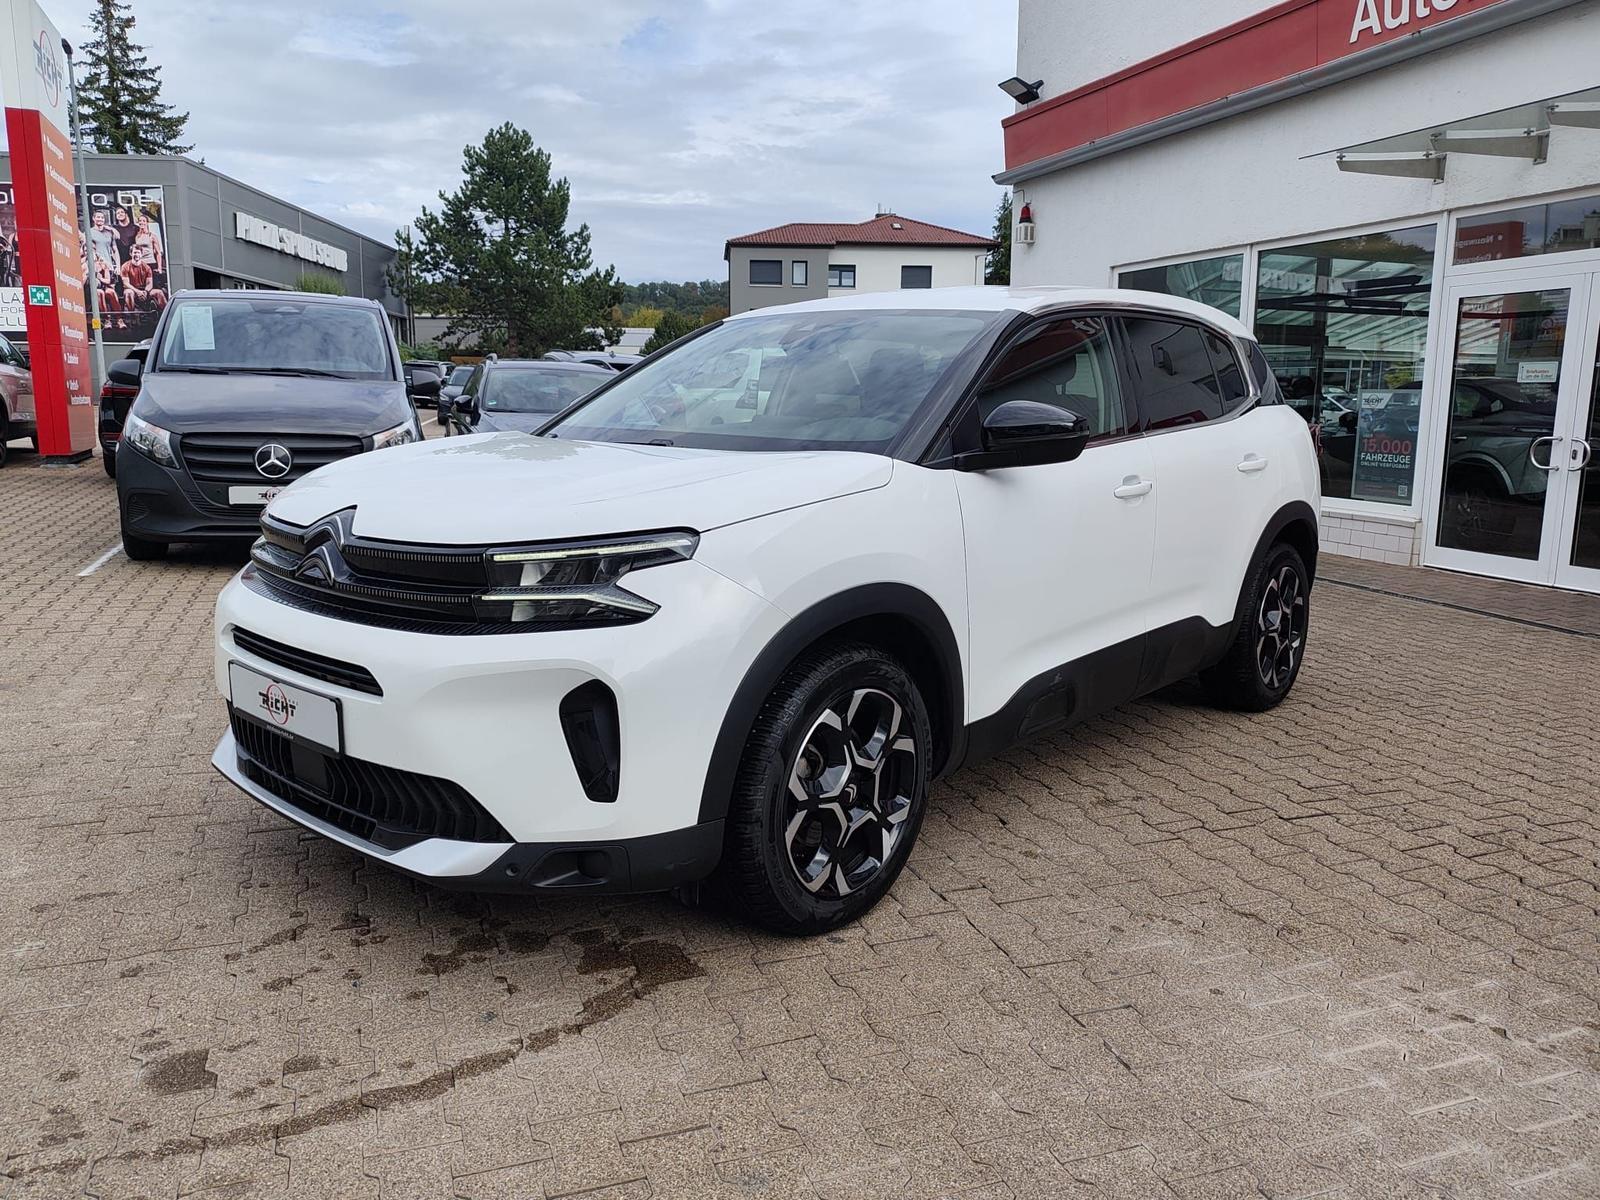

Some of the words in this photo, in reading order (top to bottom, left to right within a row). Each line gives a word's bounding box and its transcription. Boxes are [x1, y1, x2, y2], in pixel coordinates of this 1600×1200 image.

[1349, 0, 1458, 44] Au
[117, 191, 153, 207] be
[1361, 438, 1412, 455] 15.000
[1360, 452, 1411, 464] FAHRZEUGE
